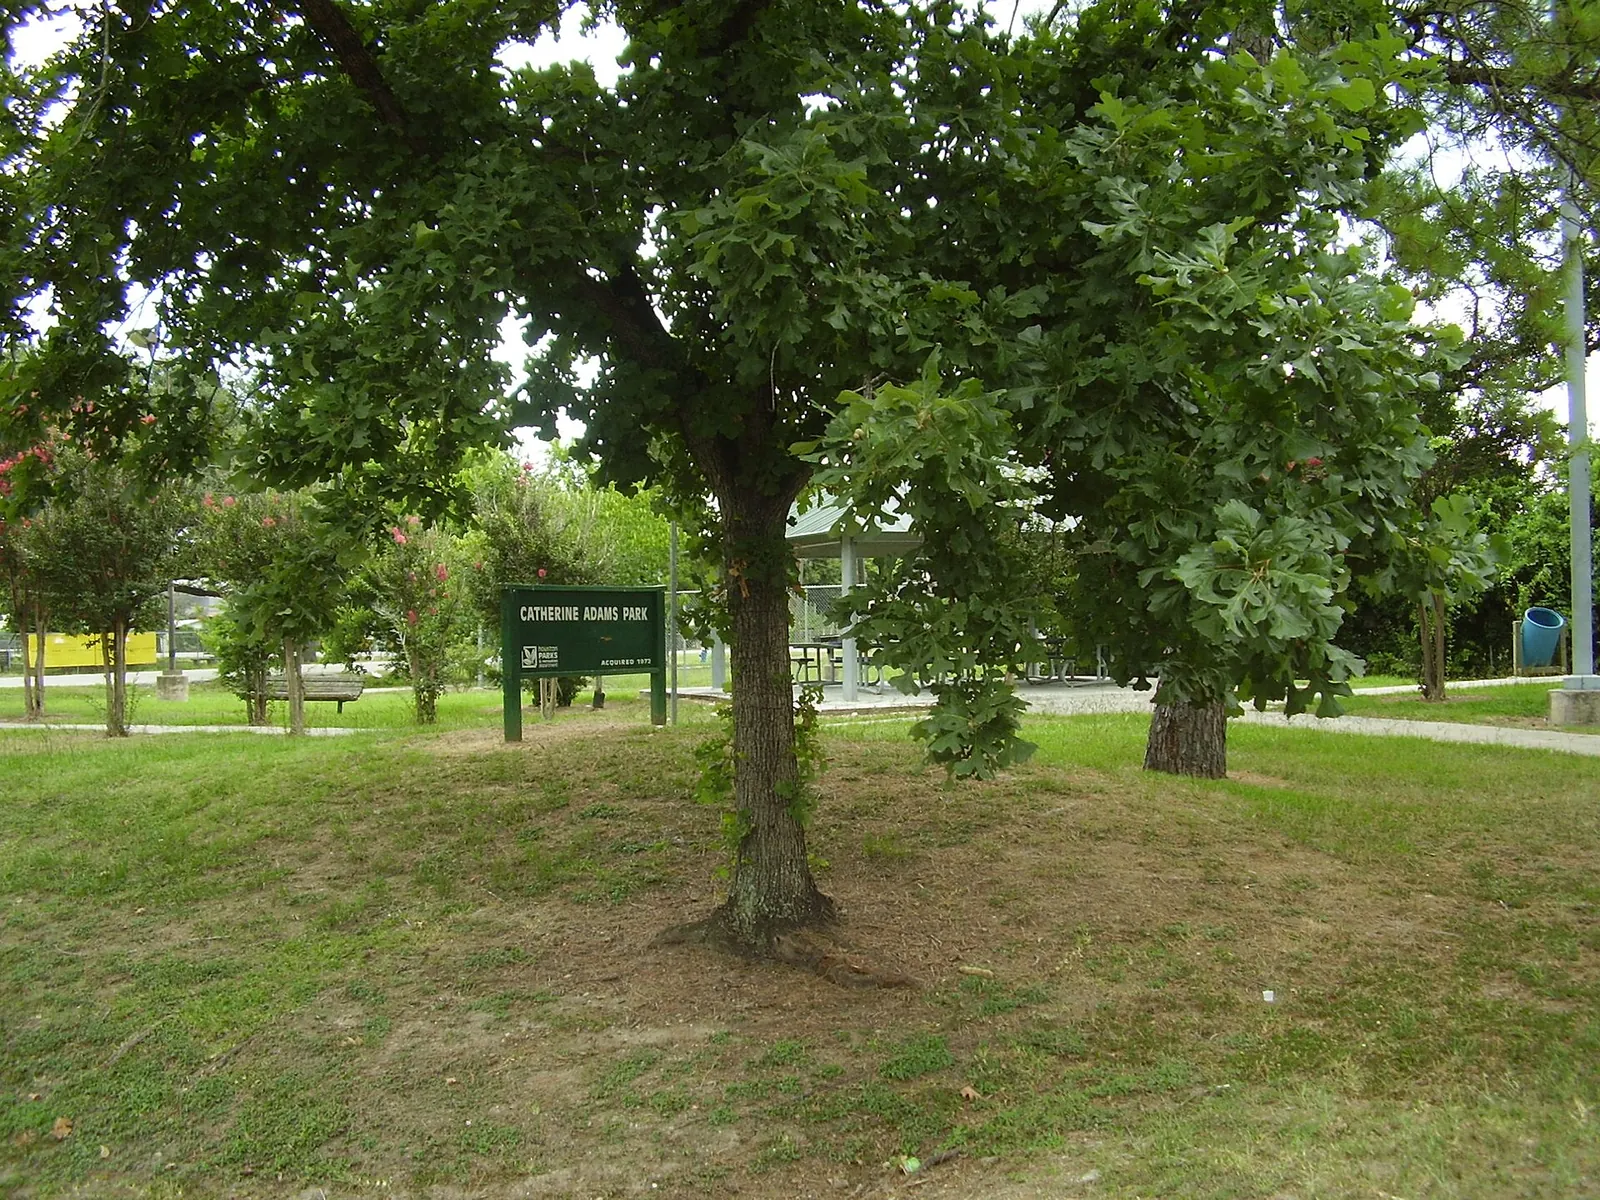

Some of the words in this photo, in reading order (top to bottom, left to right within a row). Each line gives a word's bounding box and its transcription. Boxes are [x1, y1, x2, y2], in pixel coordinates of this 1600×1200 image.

[520, 606, 579, 621] CATHERINE
[583, 606, 619, 621] ADAMS
[622, 606, 648, 621] PARK
